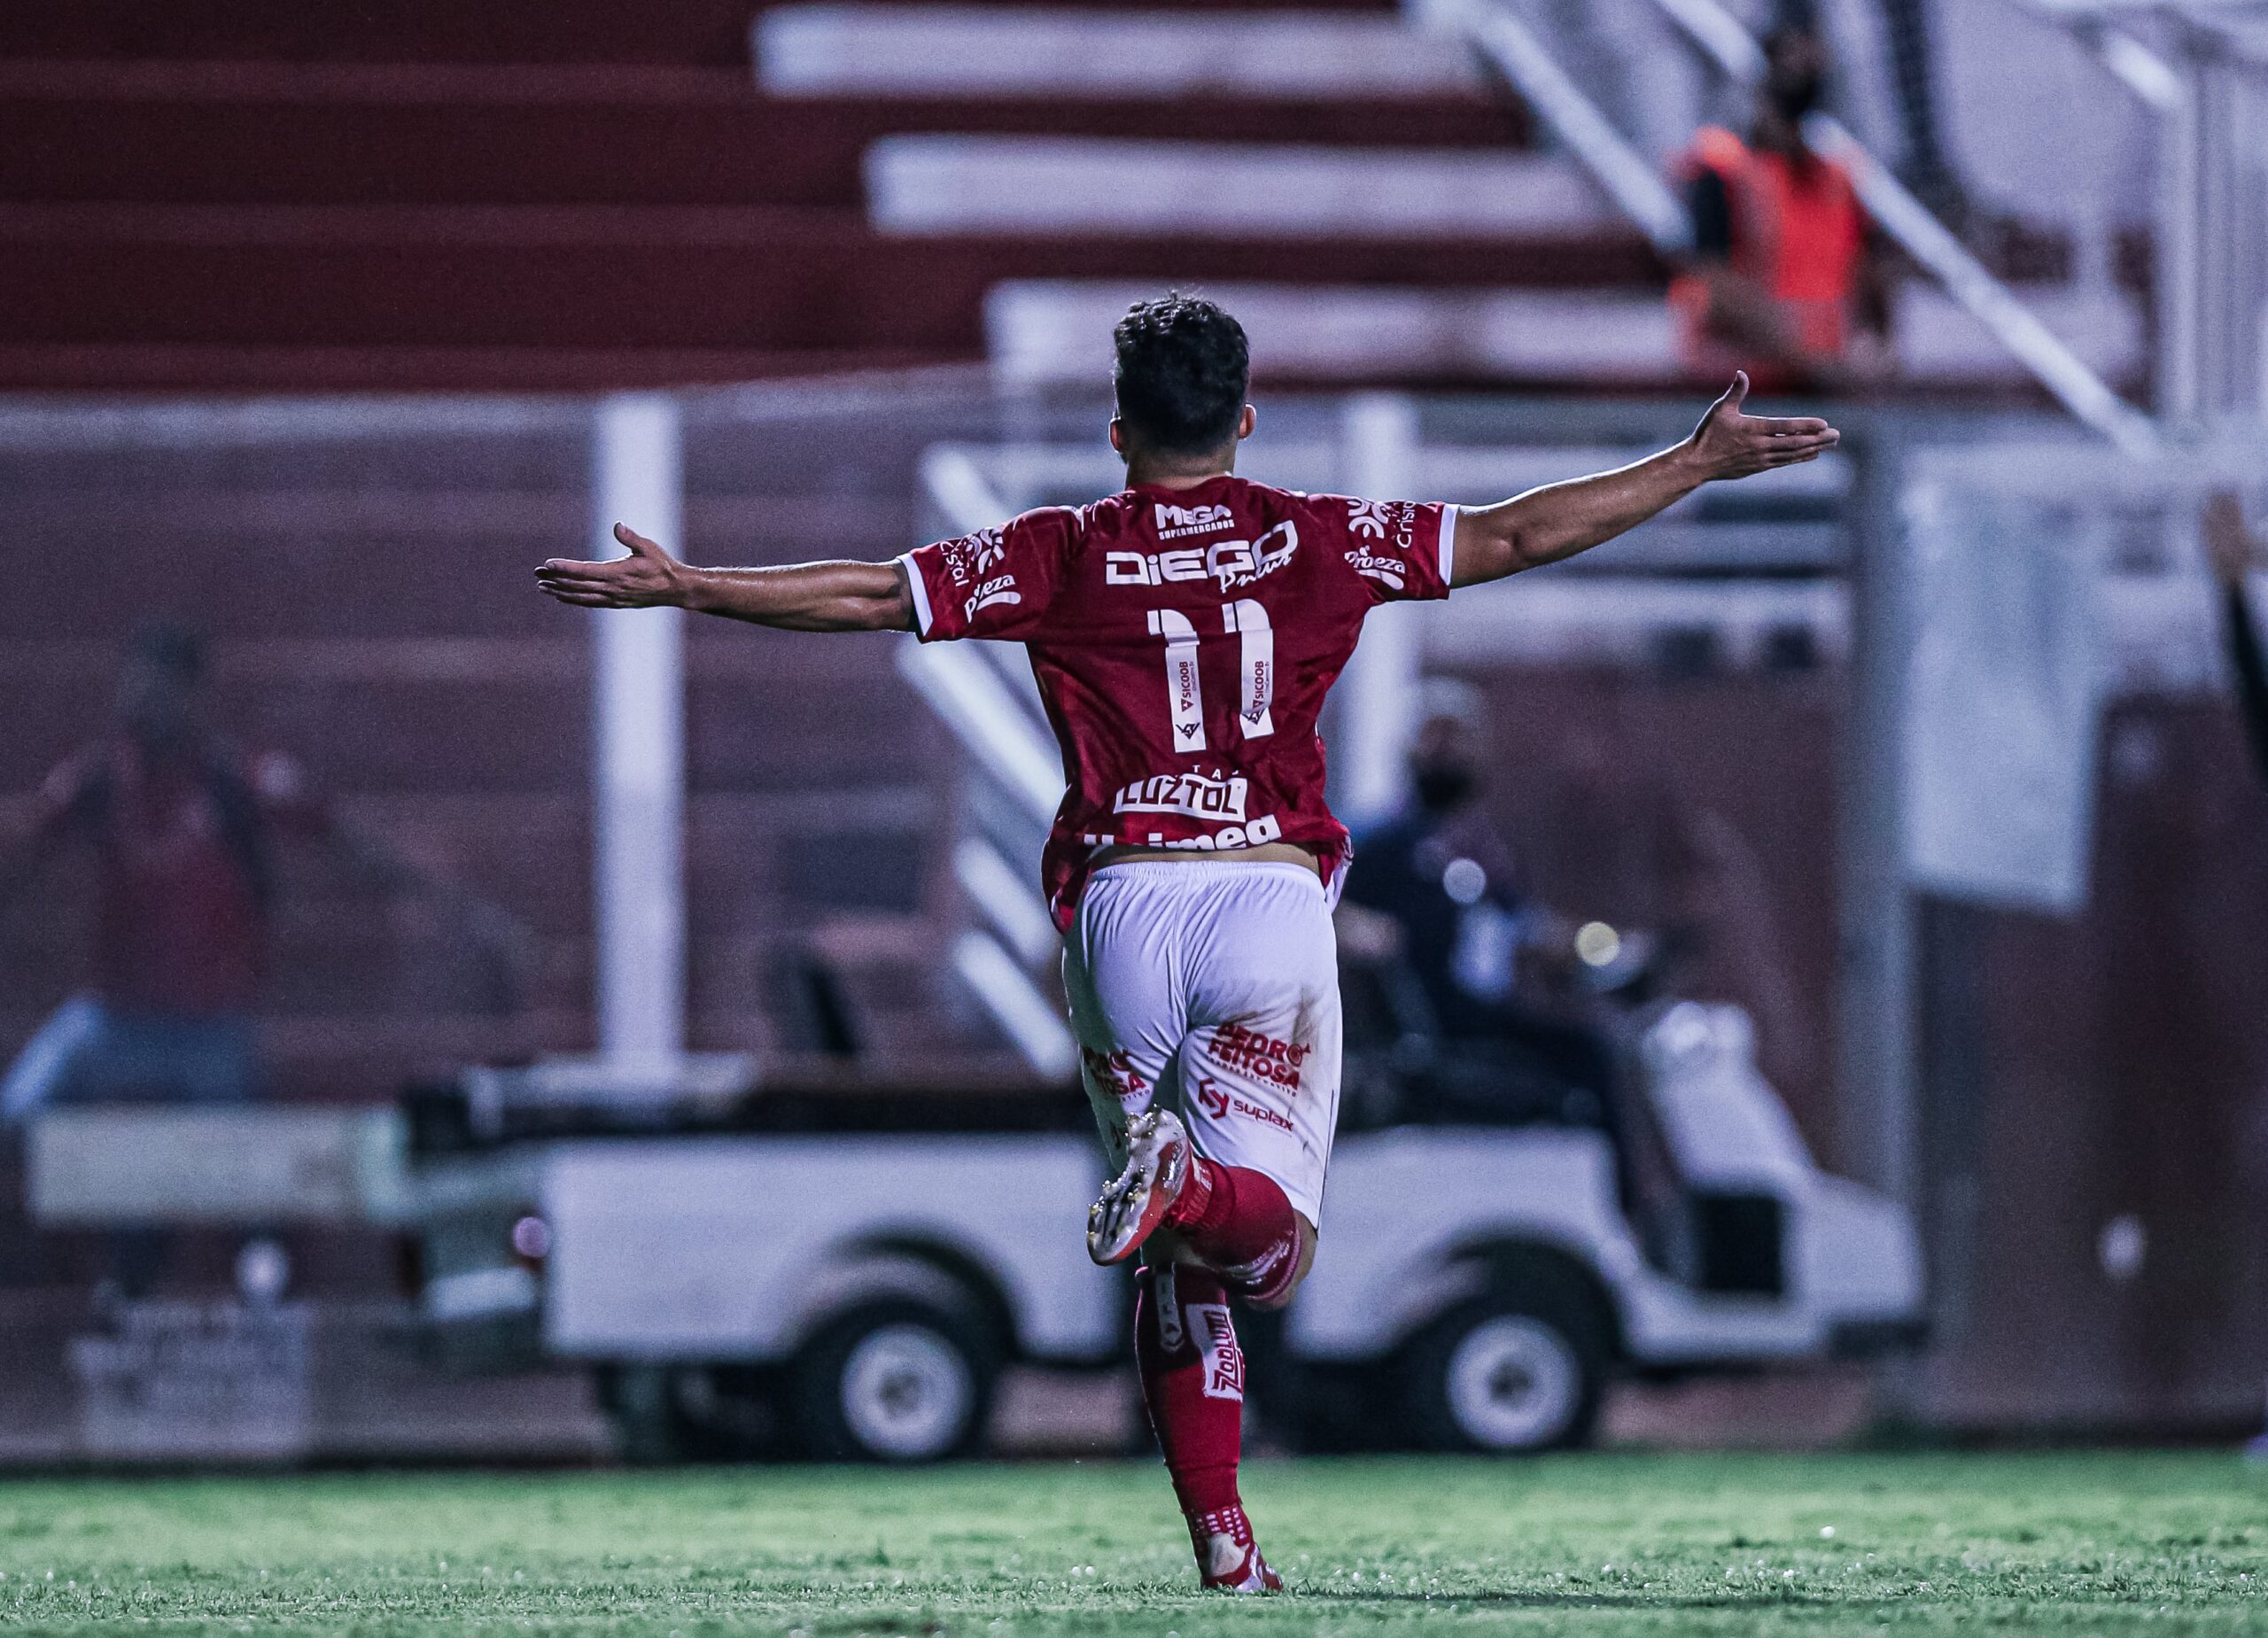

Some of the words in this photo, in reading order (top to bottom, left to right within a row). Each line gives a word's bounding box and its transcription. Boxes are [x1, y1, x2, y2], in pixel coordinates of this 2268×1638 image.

[1158, 519, 1235, 540] SUPERMERCADOS
[1179, 661, 1192, 698] SICOOB
[1254, 660, 1264, 699] SICOOB
[1122, 777, 1239, 815] LUZTOL
[1233, 1099, 1293, 1131] suplax
